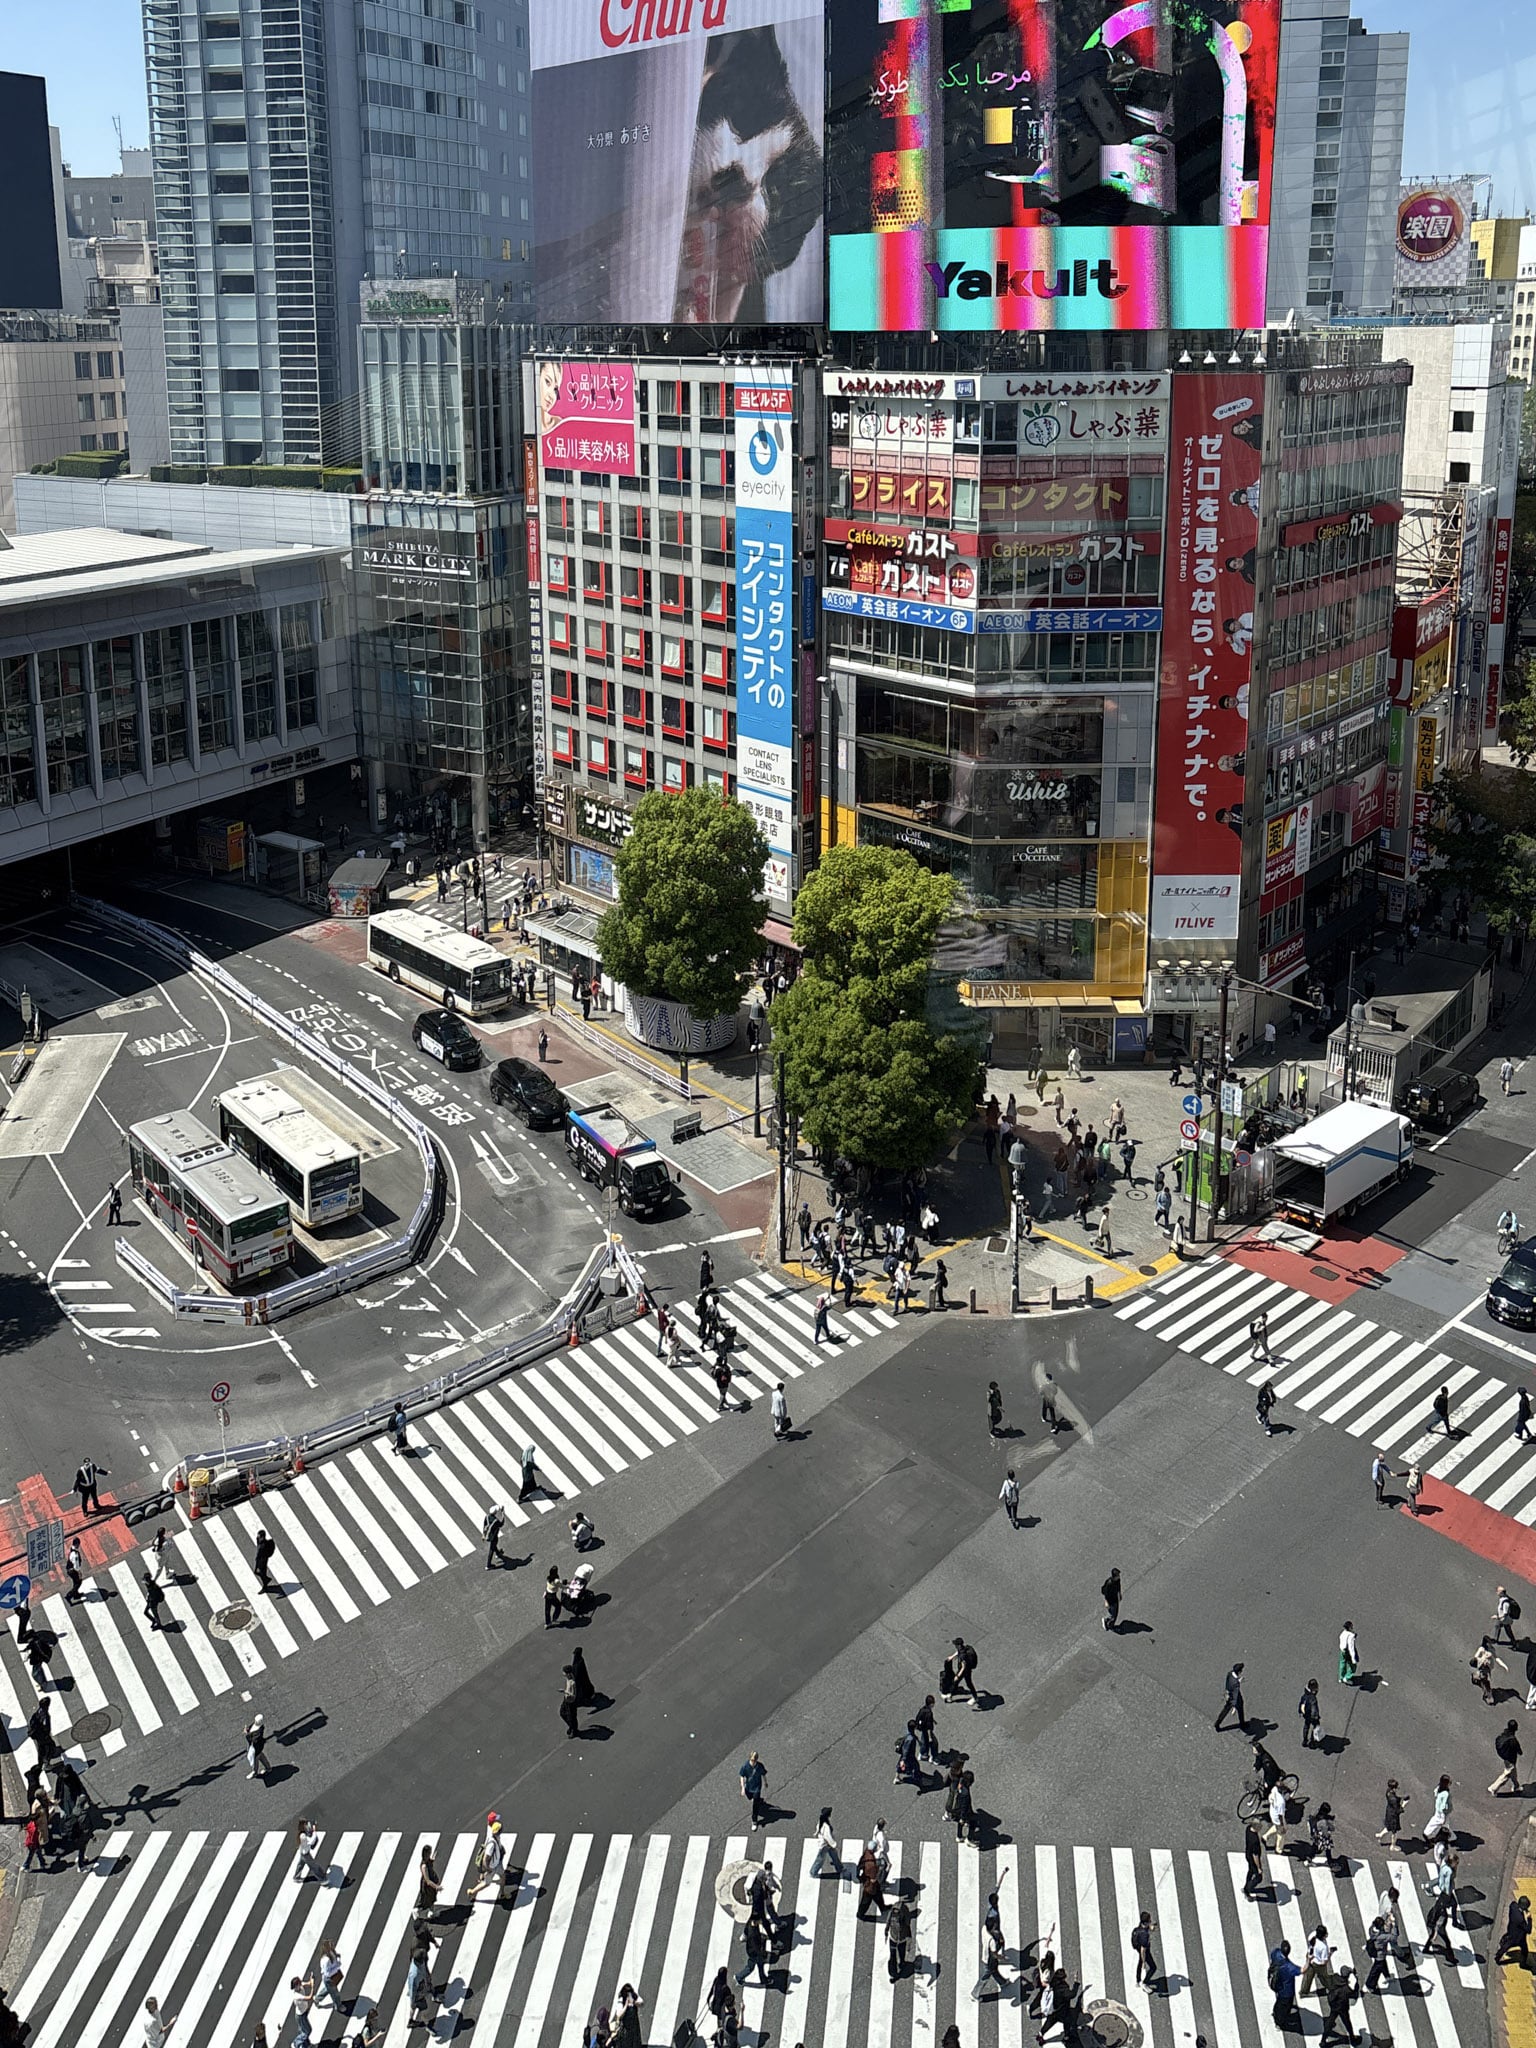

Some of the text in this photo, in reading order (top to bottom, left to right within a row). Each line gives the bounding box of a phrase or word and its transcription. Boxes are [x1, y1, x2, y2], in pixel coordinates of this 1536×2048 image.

[976, 62, 1031, 92] مرحبا
[587, 124, 651, 149] 大分県 あずき
[1403, 215, 1453, 240] 楽園
[924, 258, 1130, 300] Yakult
[580, 374, 628, 391] 品川スキン
[838, 377, 945, 396] しゃぶしゃぶバイキング
[1006, 377, 1161, 397] しゃぶしゃぶバイキング
[580, 394, 624, 412] クリニック
[740, 390, 787, 409] 当ビル5F
[831, 412, 849, 430] 9F
[886, 407, 947, 438] しゃぶ葉
[1069, 406, 1160, 438] しゃぶ葉
[555, 437, 630, 464] 品川美容外科
[742, 479, 785, 500] eyecity
[851, 475, 949, 510] プライス
[981, 482, 1122, 511] コンタクト
[1349, 512, 1374, 538] ガスト
[388, 541, 440, 553] SHIBUYA
[907, 530, 956, 559] ガスト
[1078, 536, 1145, 562] ガスト
[363, 550, 471, 571] MARK CITY
[829, 555, 849, 576] 7F
[881, 559, 940, 596] ガスト
[827, 592, 854, 609] AEON
[861, 597, 946, 624] 英会話イーオン
[740, 539, 765, 704] アイシティ
[768, 542, 785, 709] コンタクトの
[984, 615, 1025, 629] AEON
[1035, 612, 1158, 631] 英会話イーオン
[1377, 700, 1391, 720] 4F
[748, 746, 779, 763] CONTACT
[755, 759, 772, 771] LENS
[743, 766, 786, 786] SPECIALISTS
[1006, 781, 1068, 801] Ushi8
[1358, 794, 1379, 819] アコム
[896, 833, 931, 850] L'OCCITANE
[1268, 822, 1282, 854] 薬
[1012, 852, 1062, 862] L'OCCITANE
[1342, 840, 1374, 878] LUSH
[1265, 858, 1295, 884] サンドラッグ
[1175, 917, 1215, 928] 17LIVE
[36, 1529, 49, 1571] 渋谷駅前
